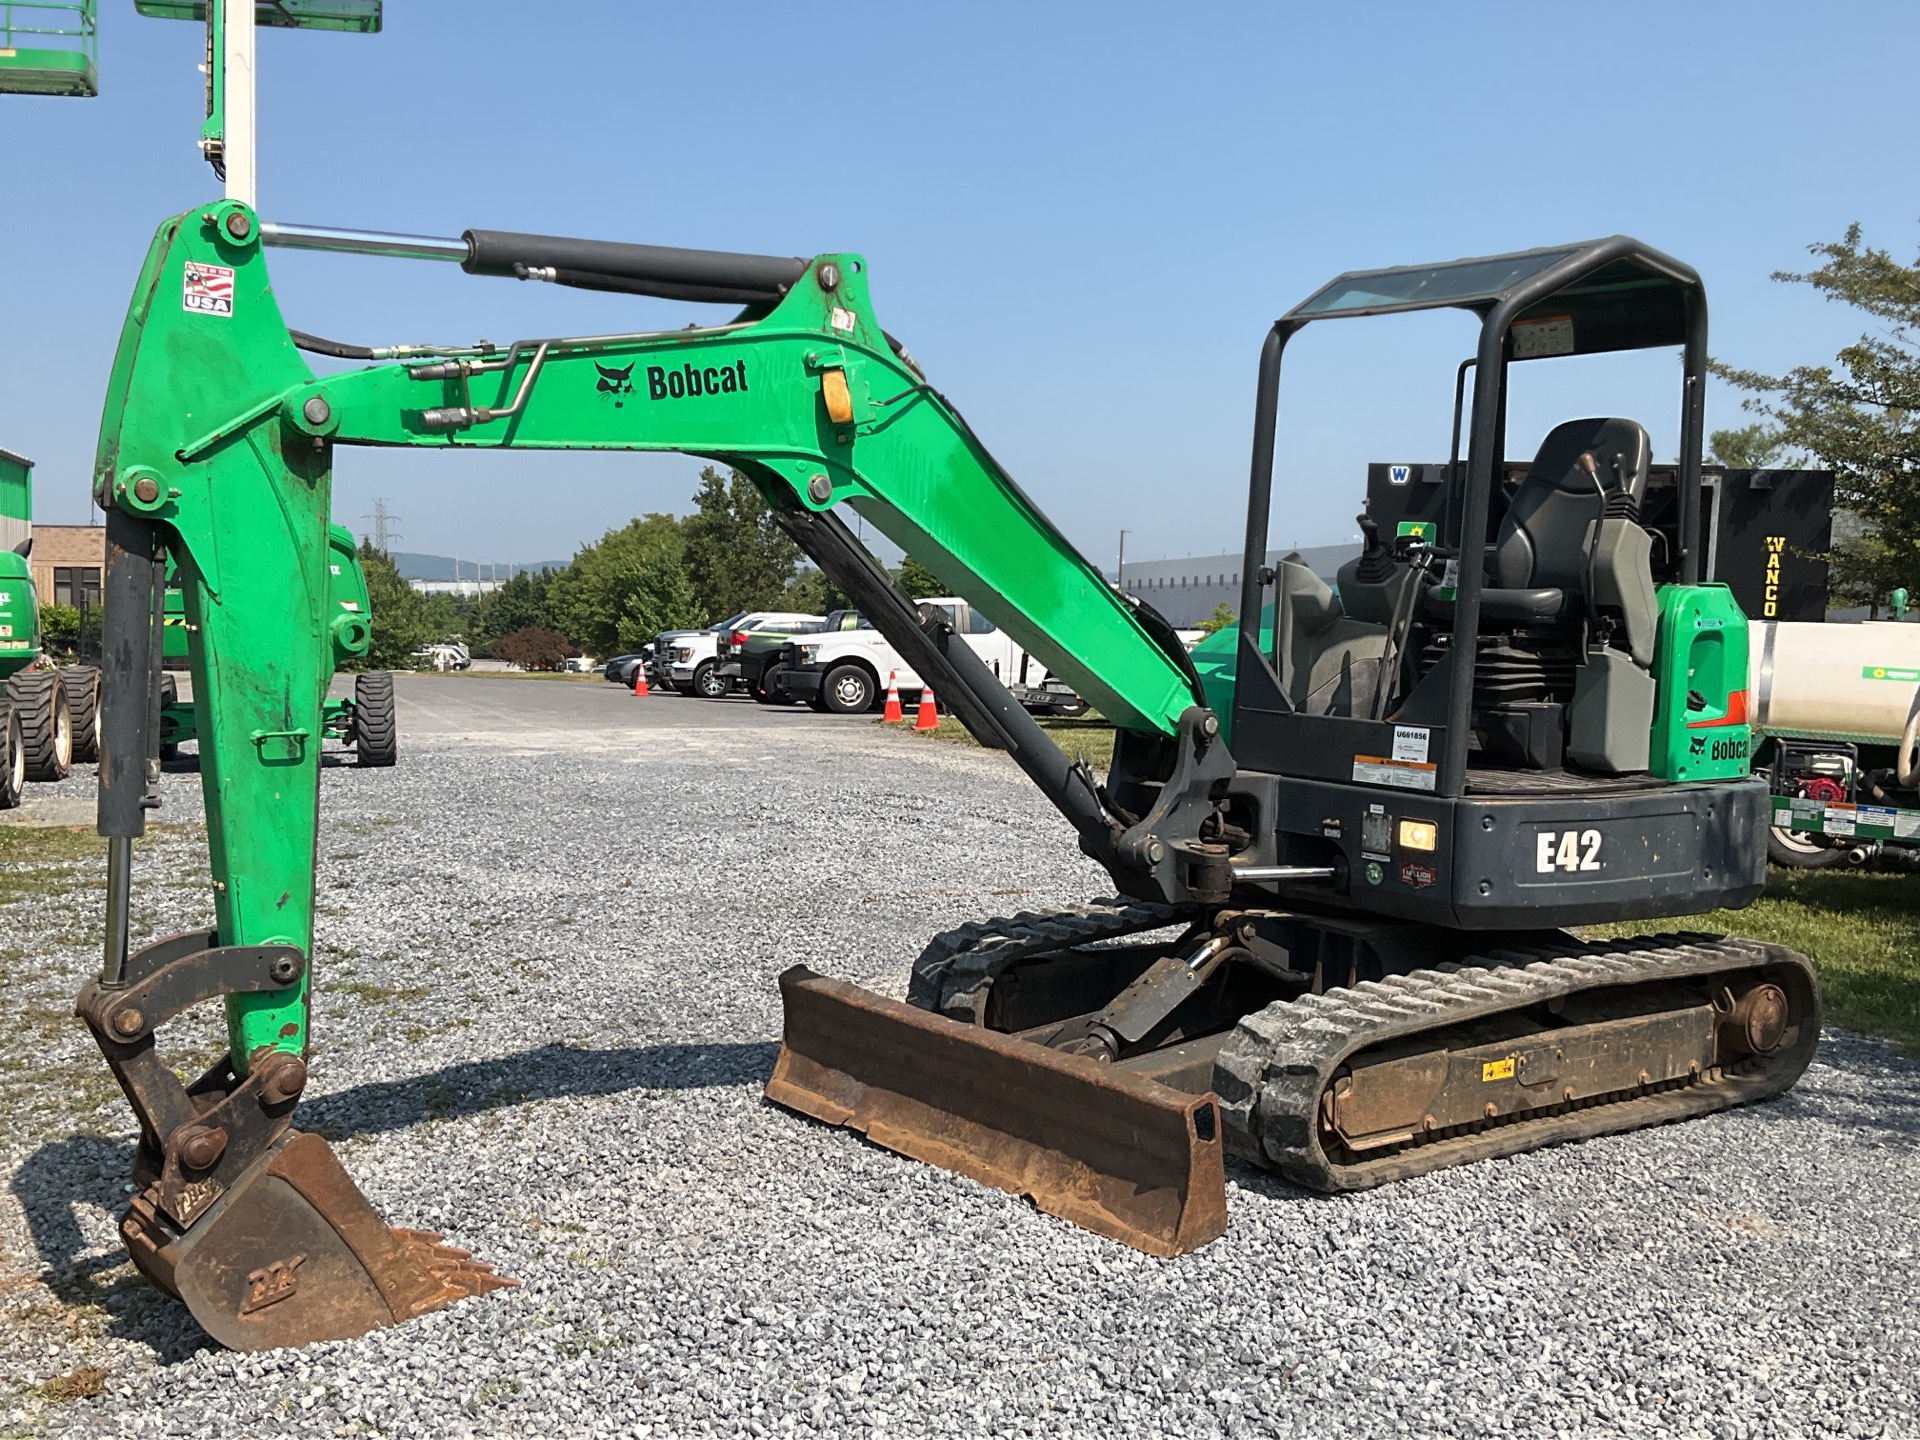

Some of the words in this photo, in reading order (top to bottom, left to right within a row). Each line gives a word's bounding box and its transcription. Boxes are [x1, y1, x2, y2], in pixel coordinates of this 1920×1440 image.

[187, 295, 228, 311] USA
[647, 359, 748, 400] Bobcat
[1392, 467, 1406, 481] W
[1764, 536, 1786, 617] WANCO
[1711, 736, 1748, 760] Bobca
[1536, 829, 1602, 873] E42
